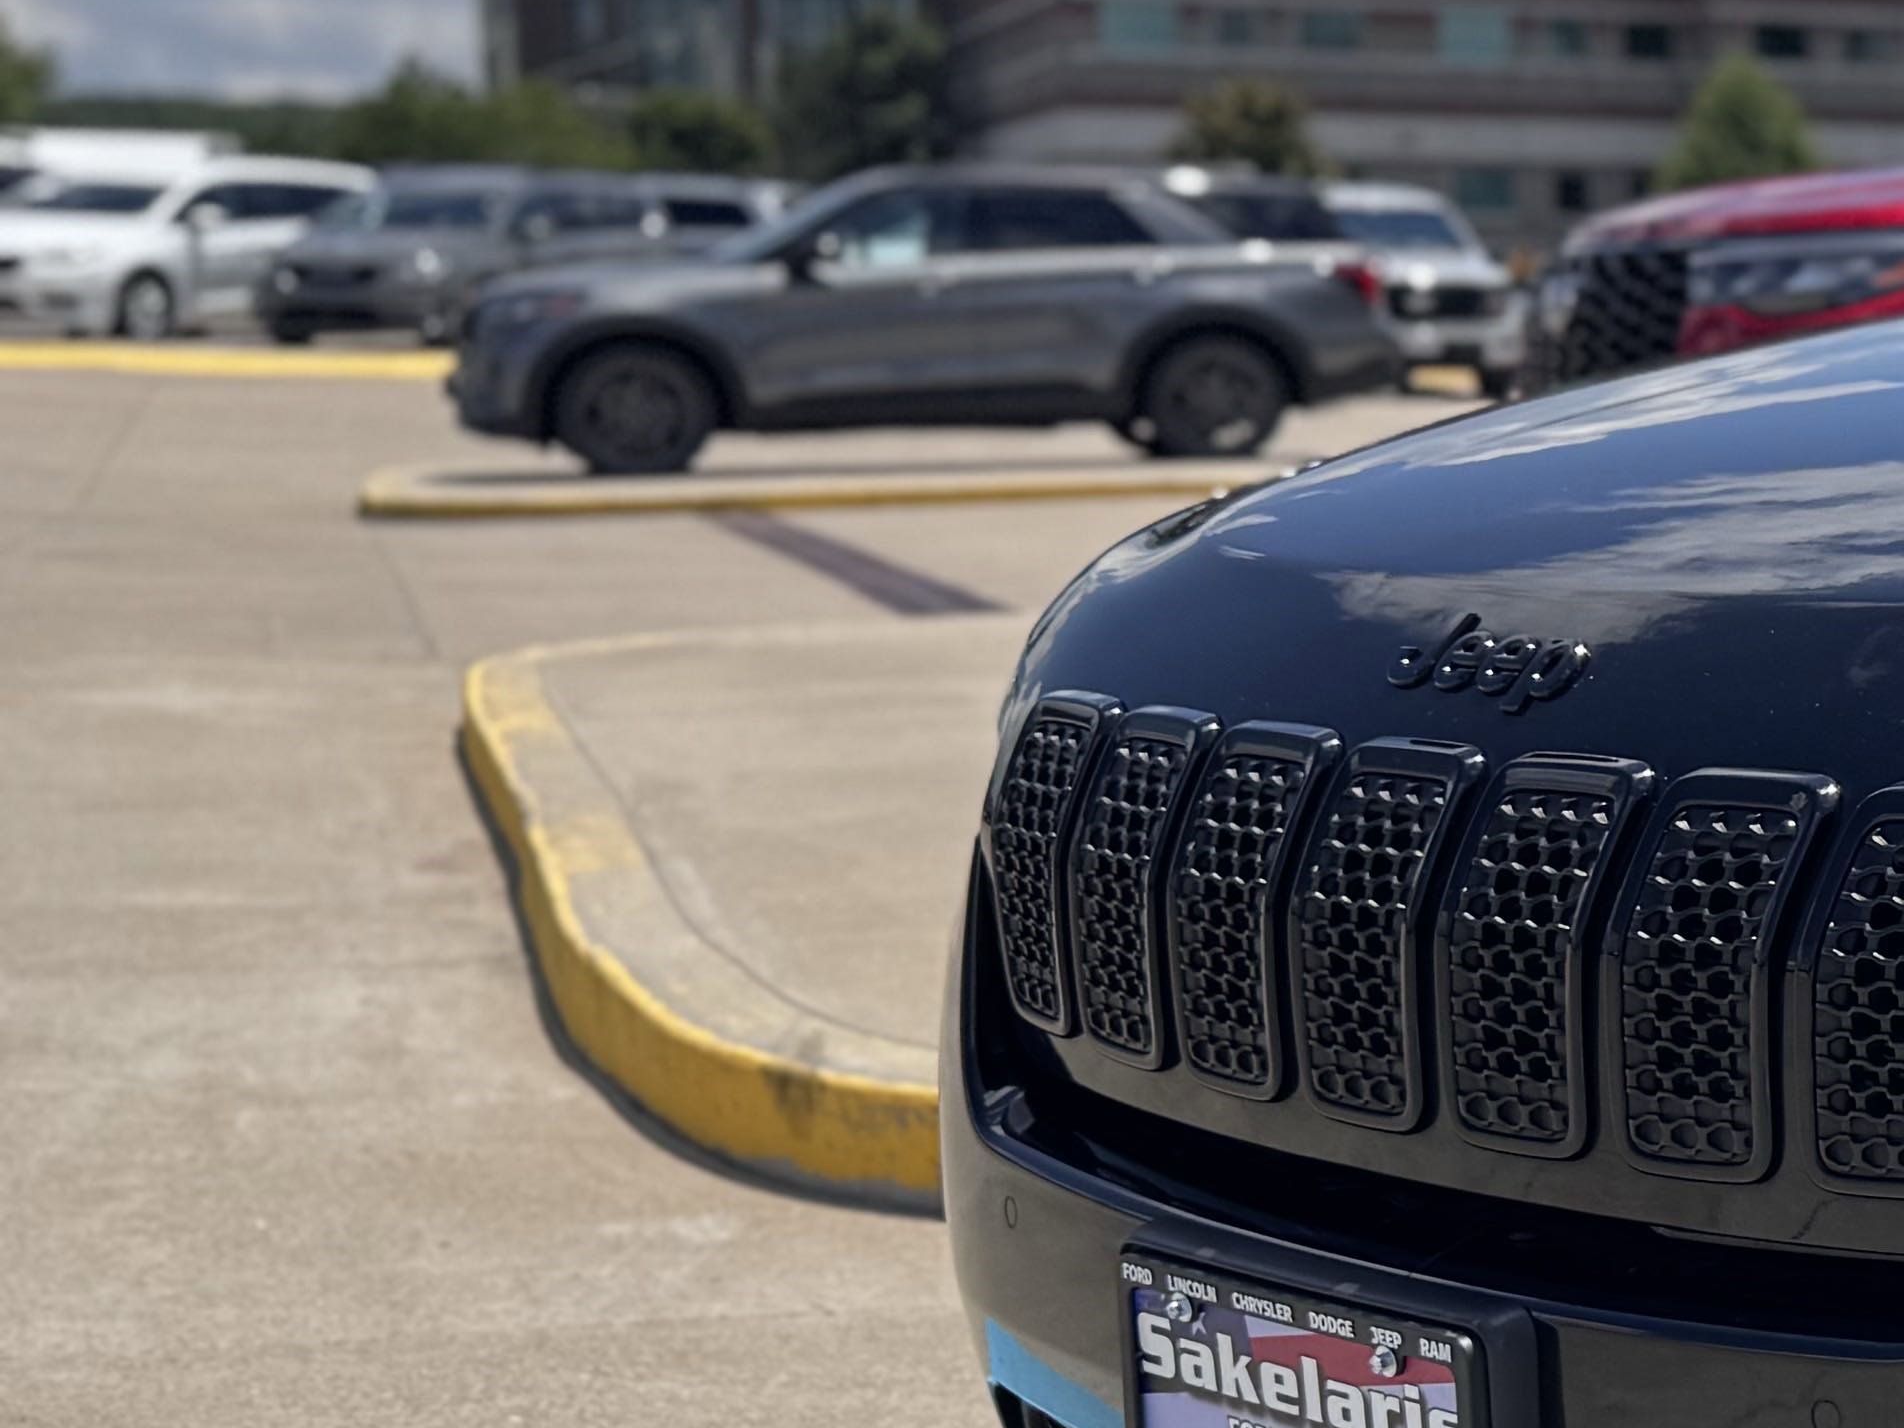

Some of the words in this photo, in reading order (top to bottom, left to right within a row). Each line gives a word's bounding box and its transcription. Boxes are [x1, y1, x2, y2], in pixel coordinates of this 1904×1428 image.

[1386, 612, 1592, 716] Jeep
[1122, 1263, 1153, 1286] FORD
[1167, 1274, 1217, 1303] LINCOLN
[1231, 1291, 1294, 1324] CHRYSLER
[1308, 1311, 1355, 1340] DODGE
[1370, 1325, 1402, 1350] JEEP
[1420, 1338, 1452, 1364] RAM
